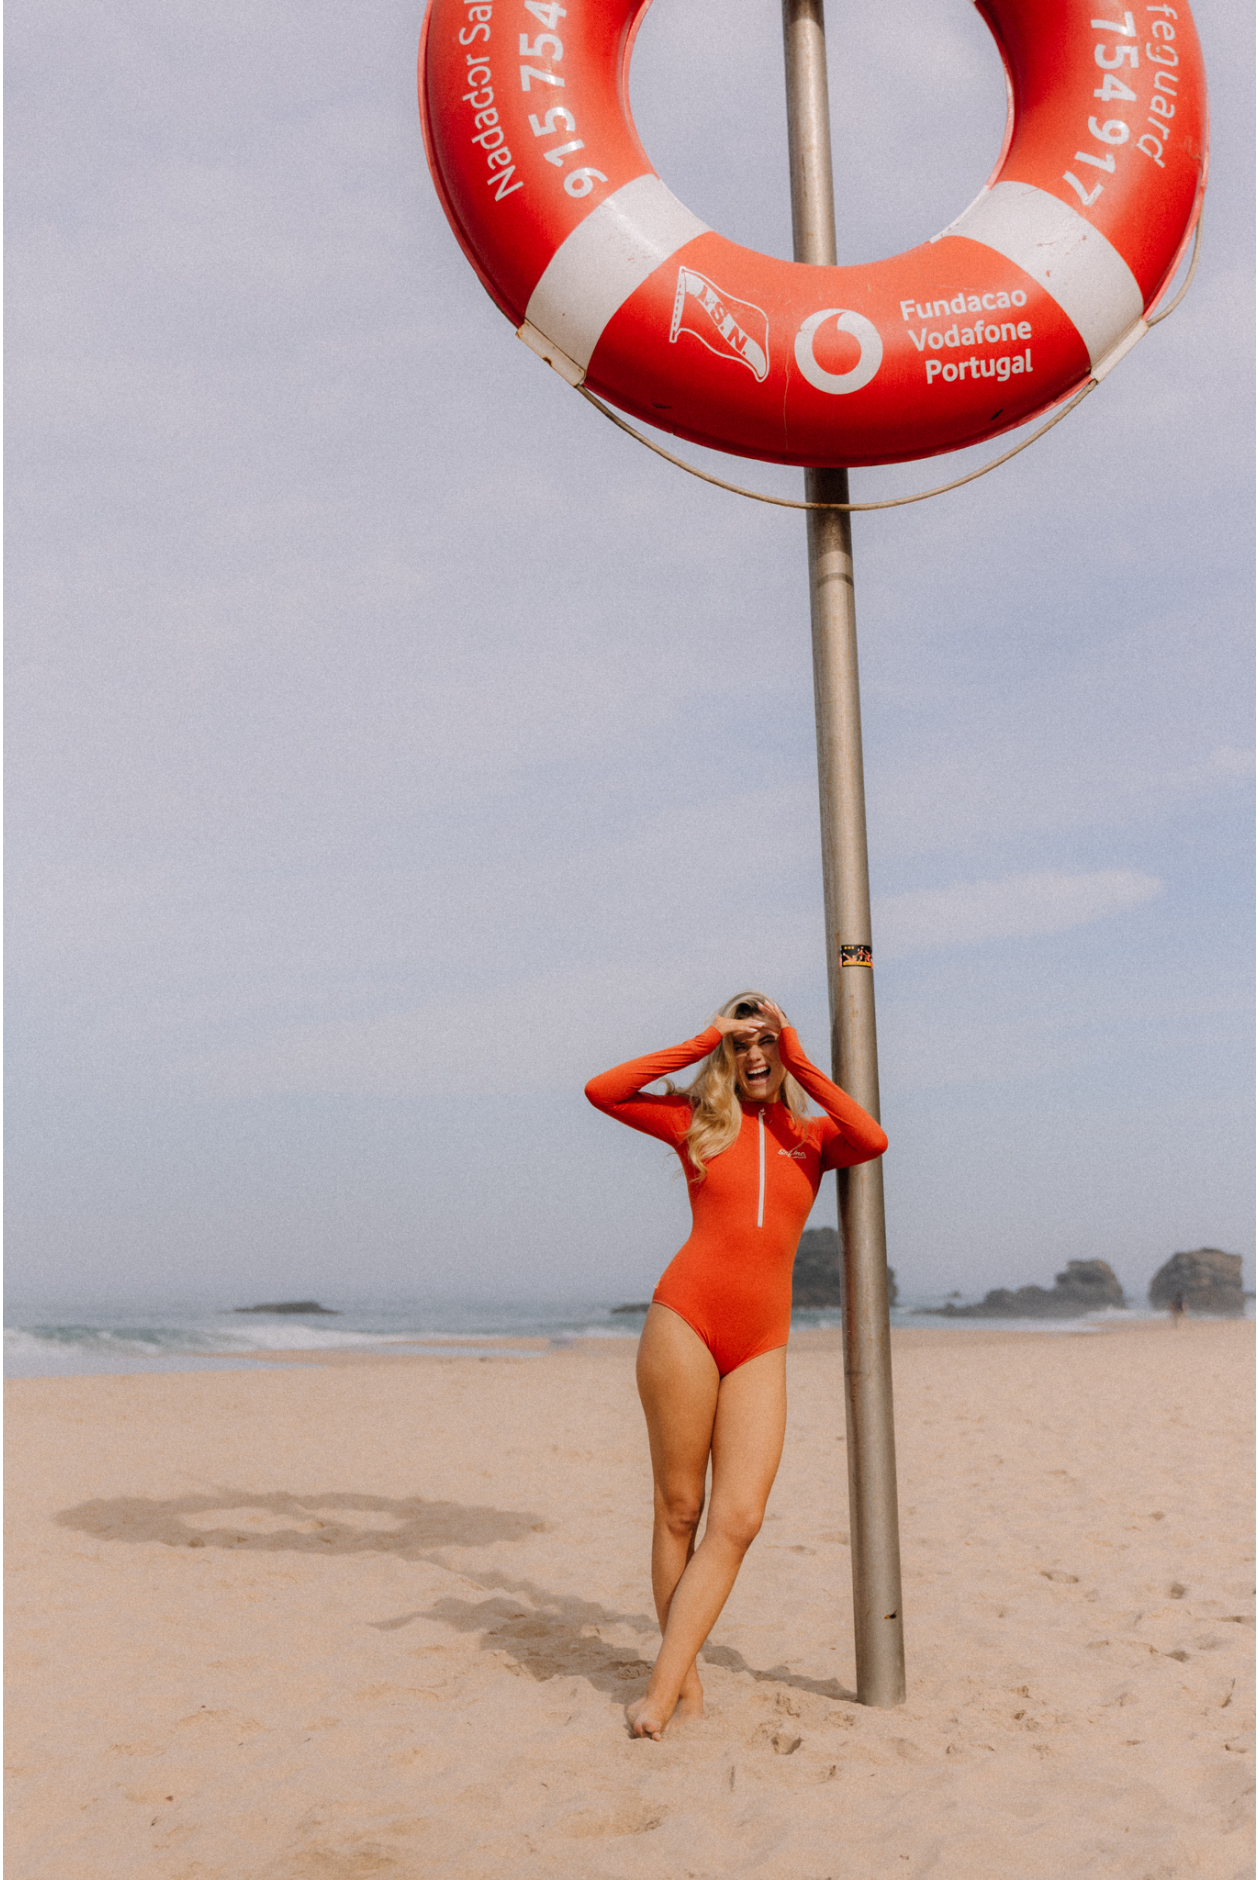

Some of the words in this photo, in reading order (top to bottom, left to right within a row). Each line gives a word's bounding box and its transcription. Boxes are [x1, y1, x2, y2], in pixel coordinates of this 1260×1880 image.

[518, 0, 568, 92] 754
[1090, 10, 1140, 102] 754
[461, 53, 524, 202] Nadador
[527, 106, 609, 199] 915
[1061, 115, 1131, 208] 917
[899, 289, 1028, 322] Fundacao
[907, 320, 1033, 352] Vodafone
[925, 348, 1034, 385] Portugal
